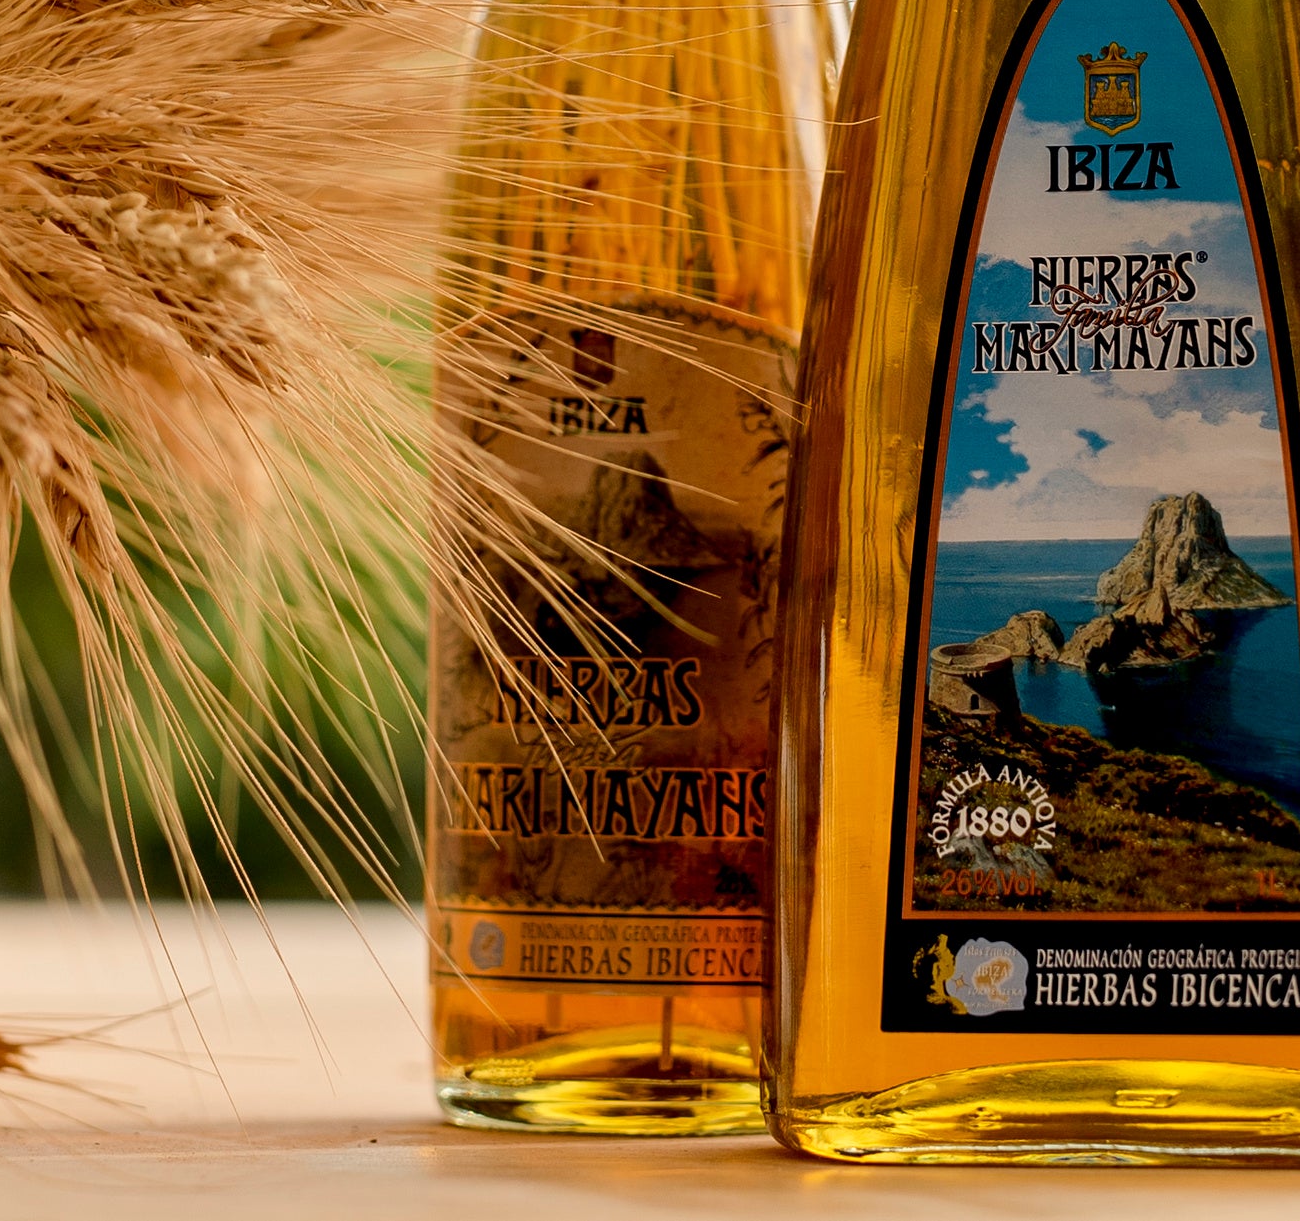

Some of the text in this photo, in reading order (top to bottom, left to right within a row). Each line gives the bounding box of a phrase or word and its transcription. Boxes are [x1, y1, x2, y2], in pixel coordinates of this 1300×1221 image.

[1045, 142, 1181, 192] IBIZA
[1029, 268, 1180, 354] Familia
[972, 316, 1257, 375] MARI MAYANS
[549, 396, 649, 434] IBIZA
[493, 658, 702, 727] HIERBAS
[560, 768, 766, 838] MAYANS
[928, 763, 992, 858] FÓRMULA
[956, 806, 1032, 837] 1880
[622, 921, 711, 944] GEOGRÁFICA
[715, 926, 762, 944] PROTE
[519, 943, 762, 978] HIERBAS IBICENC
[1036, 944, 1142, 969] DENOMINACIÓN
[1148, 944, 1236, 969] GEOGRÁFICA
[1034, 973, 1158, 1007] HIERBAS
